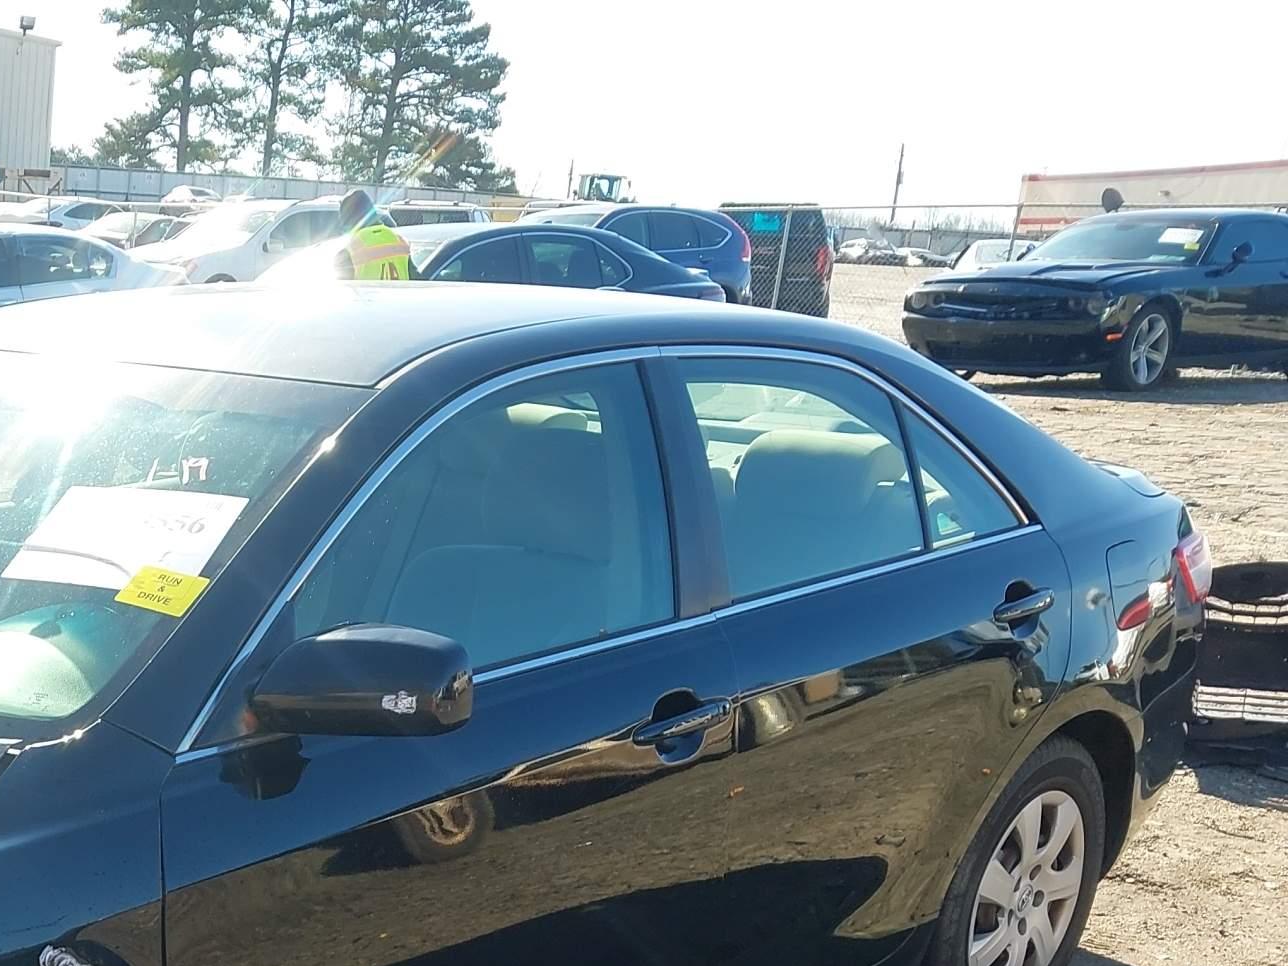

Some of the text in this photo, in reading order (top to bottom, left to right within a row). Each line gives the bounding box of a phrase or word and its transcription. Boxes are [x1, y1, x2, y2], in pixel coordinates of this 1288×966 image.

[157, 573, 183, 585] RUN
[157, 585, 166, 593] &
[137, 590, 173, 606] DRIVE
